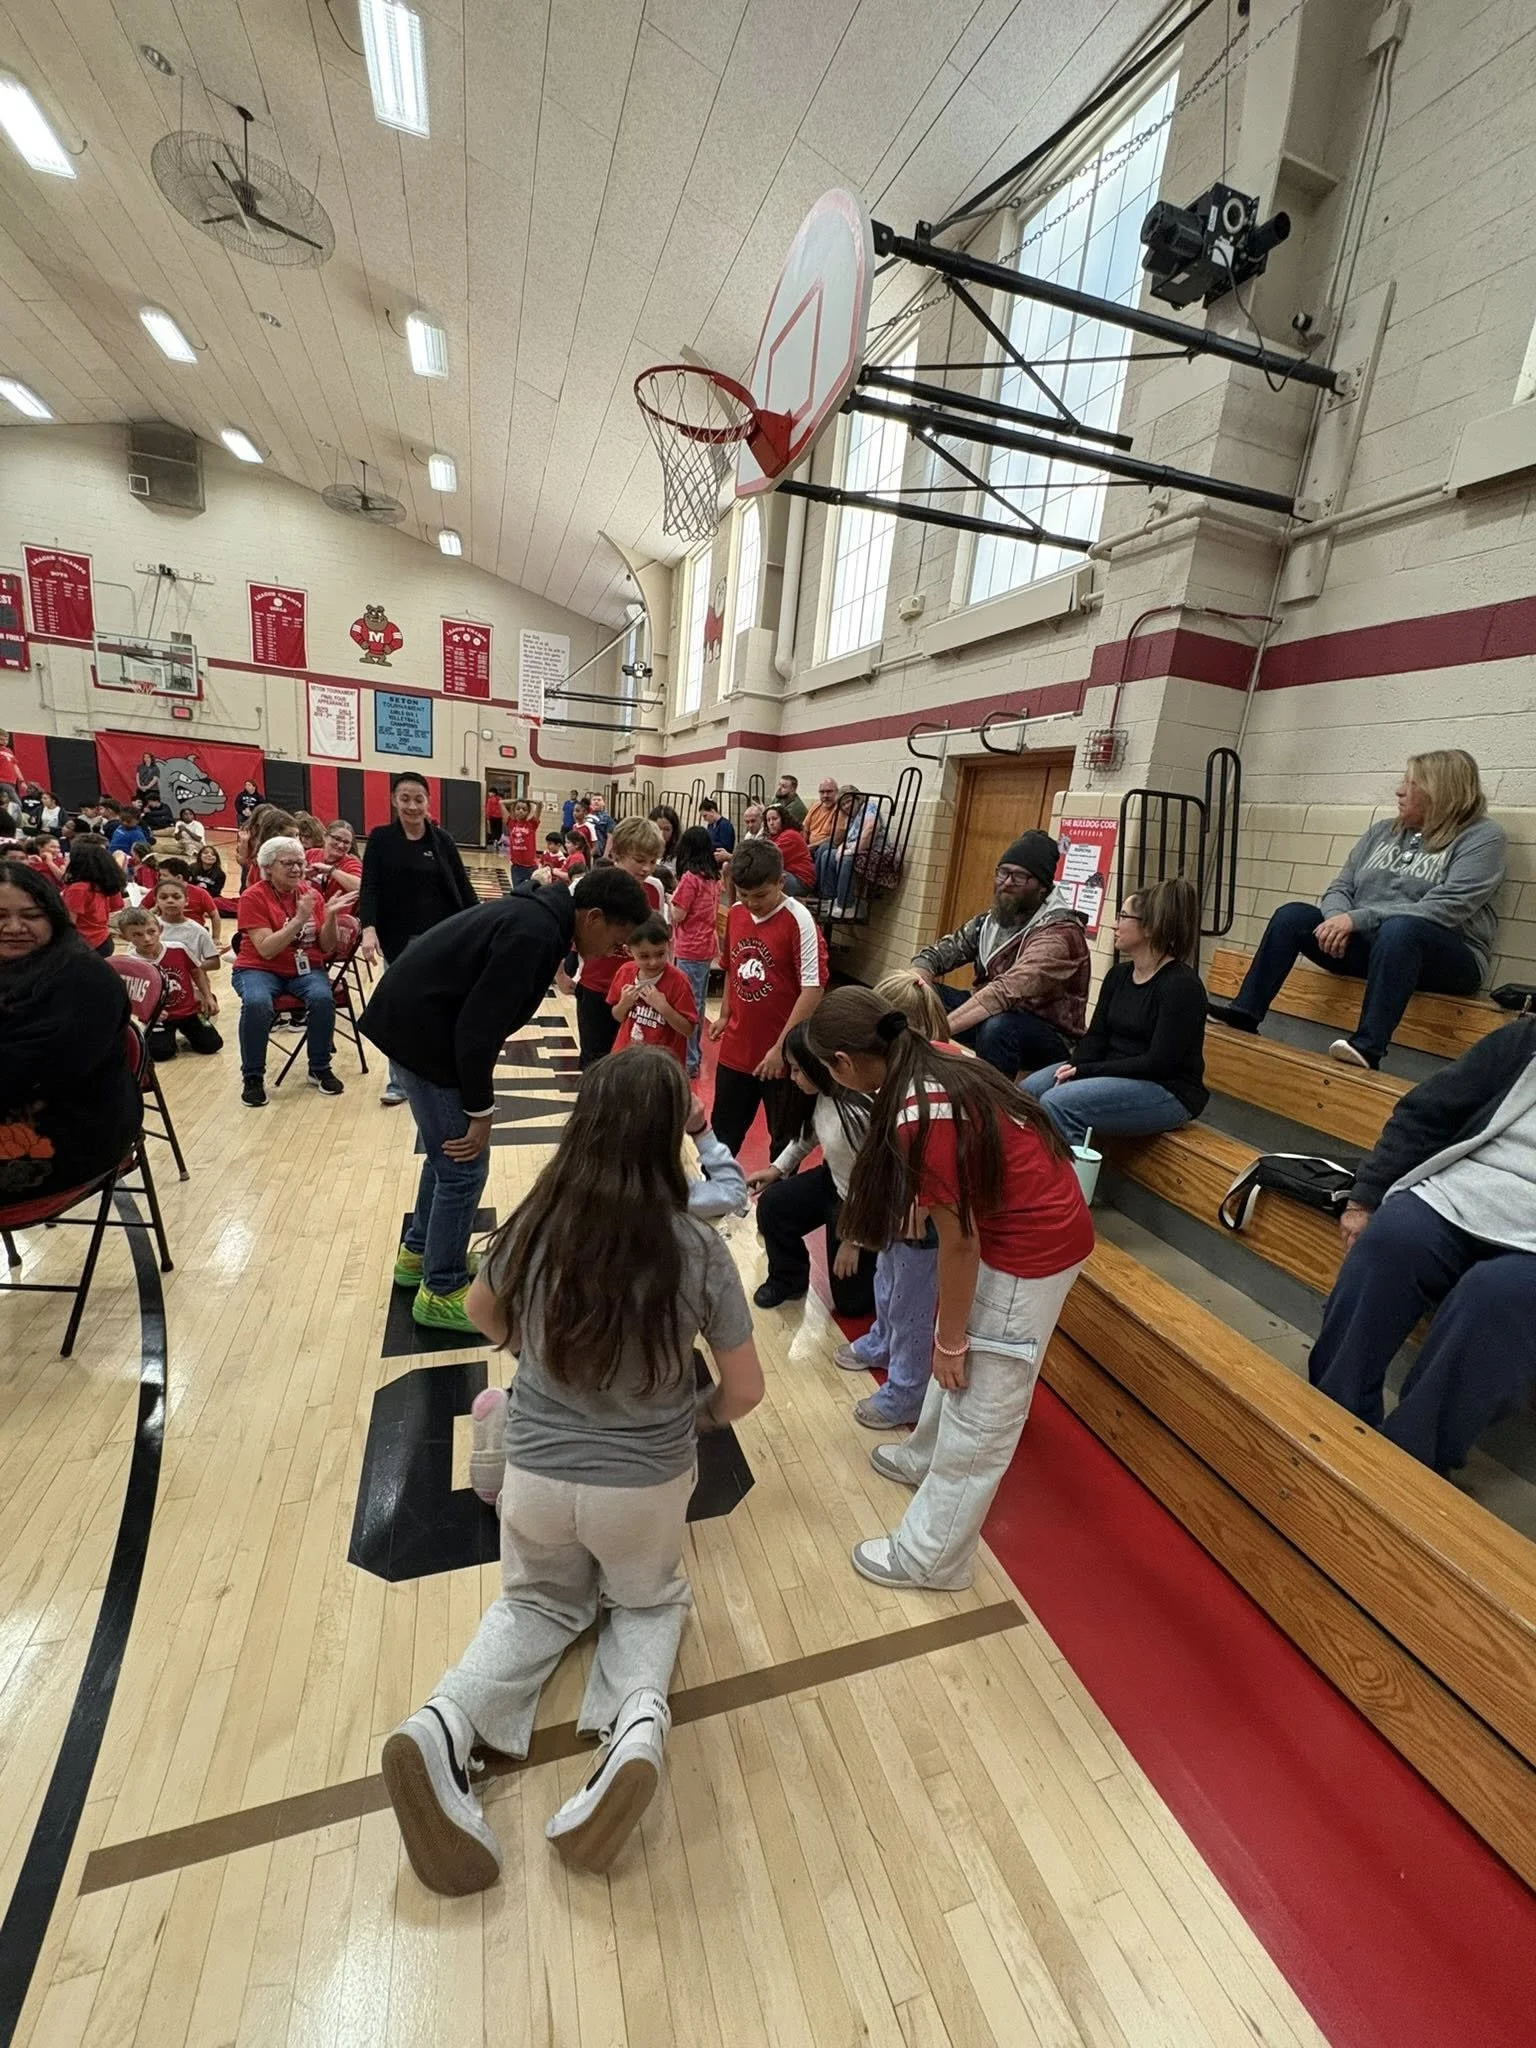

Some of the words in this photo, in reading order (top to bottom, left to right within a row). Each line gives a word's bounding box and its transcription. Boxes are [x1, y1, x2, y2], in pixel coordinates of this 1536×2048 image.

[368, 631, 385, 644] M
[390, 697, 418, 705] SETON
[383, 702, 424, 711] TOURNAMENT
[389, 715, 420, 723] VOLLEYBALL
[1062, 819, 1072, 828] THE
[1072, 819, 1100, 829] BULLDOG
[1100, 820, 1117, 829] CODE
[1069, 829, 1104, 837] CAFETERIA
[120, 974, 151, 1003] THIAS
